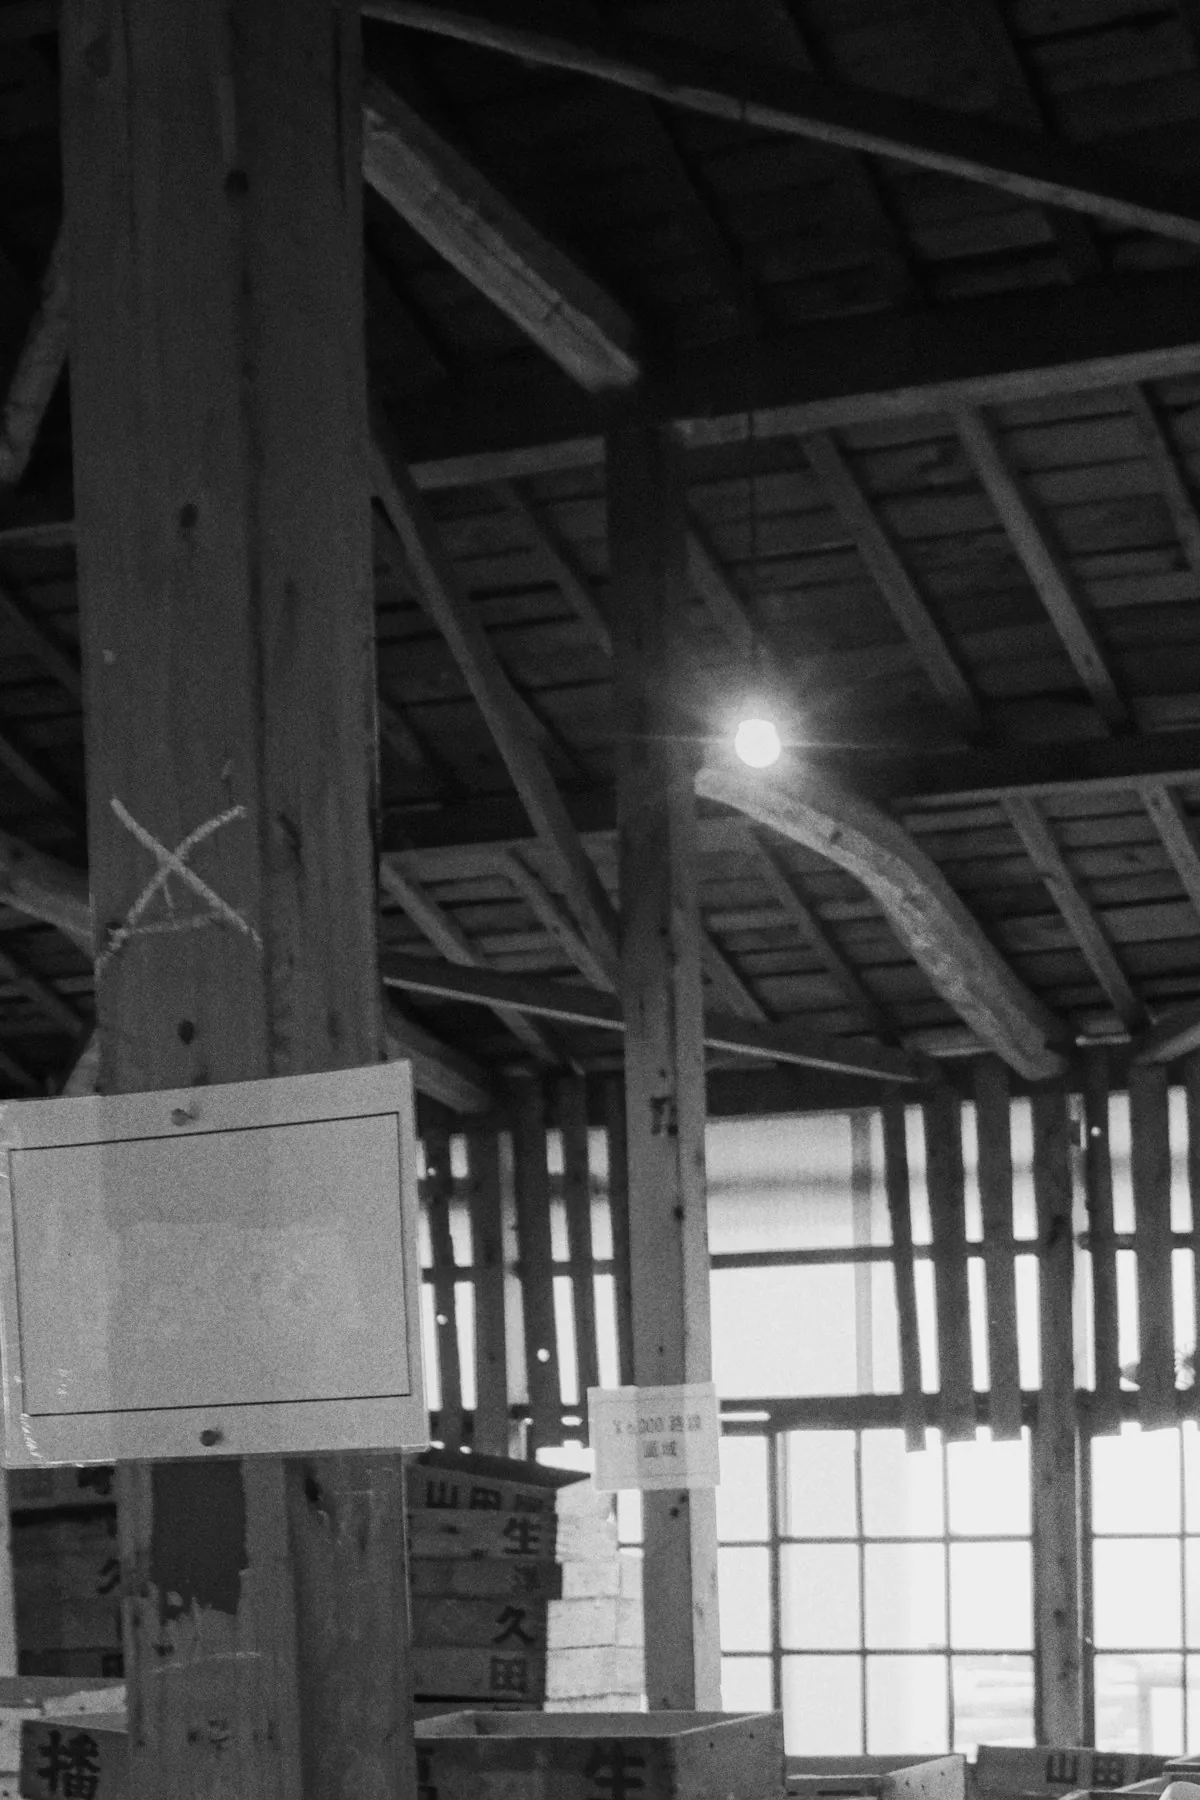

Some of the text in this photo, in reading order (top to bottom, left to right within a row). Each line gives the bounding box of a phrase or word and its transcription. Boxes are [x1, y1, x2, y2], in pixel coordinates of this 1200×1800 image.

[503, 1517, 541, 1555] 生
[492, 1604, 535, 1646] 久
[490, 1656, 527, 1693] 田
